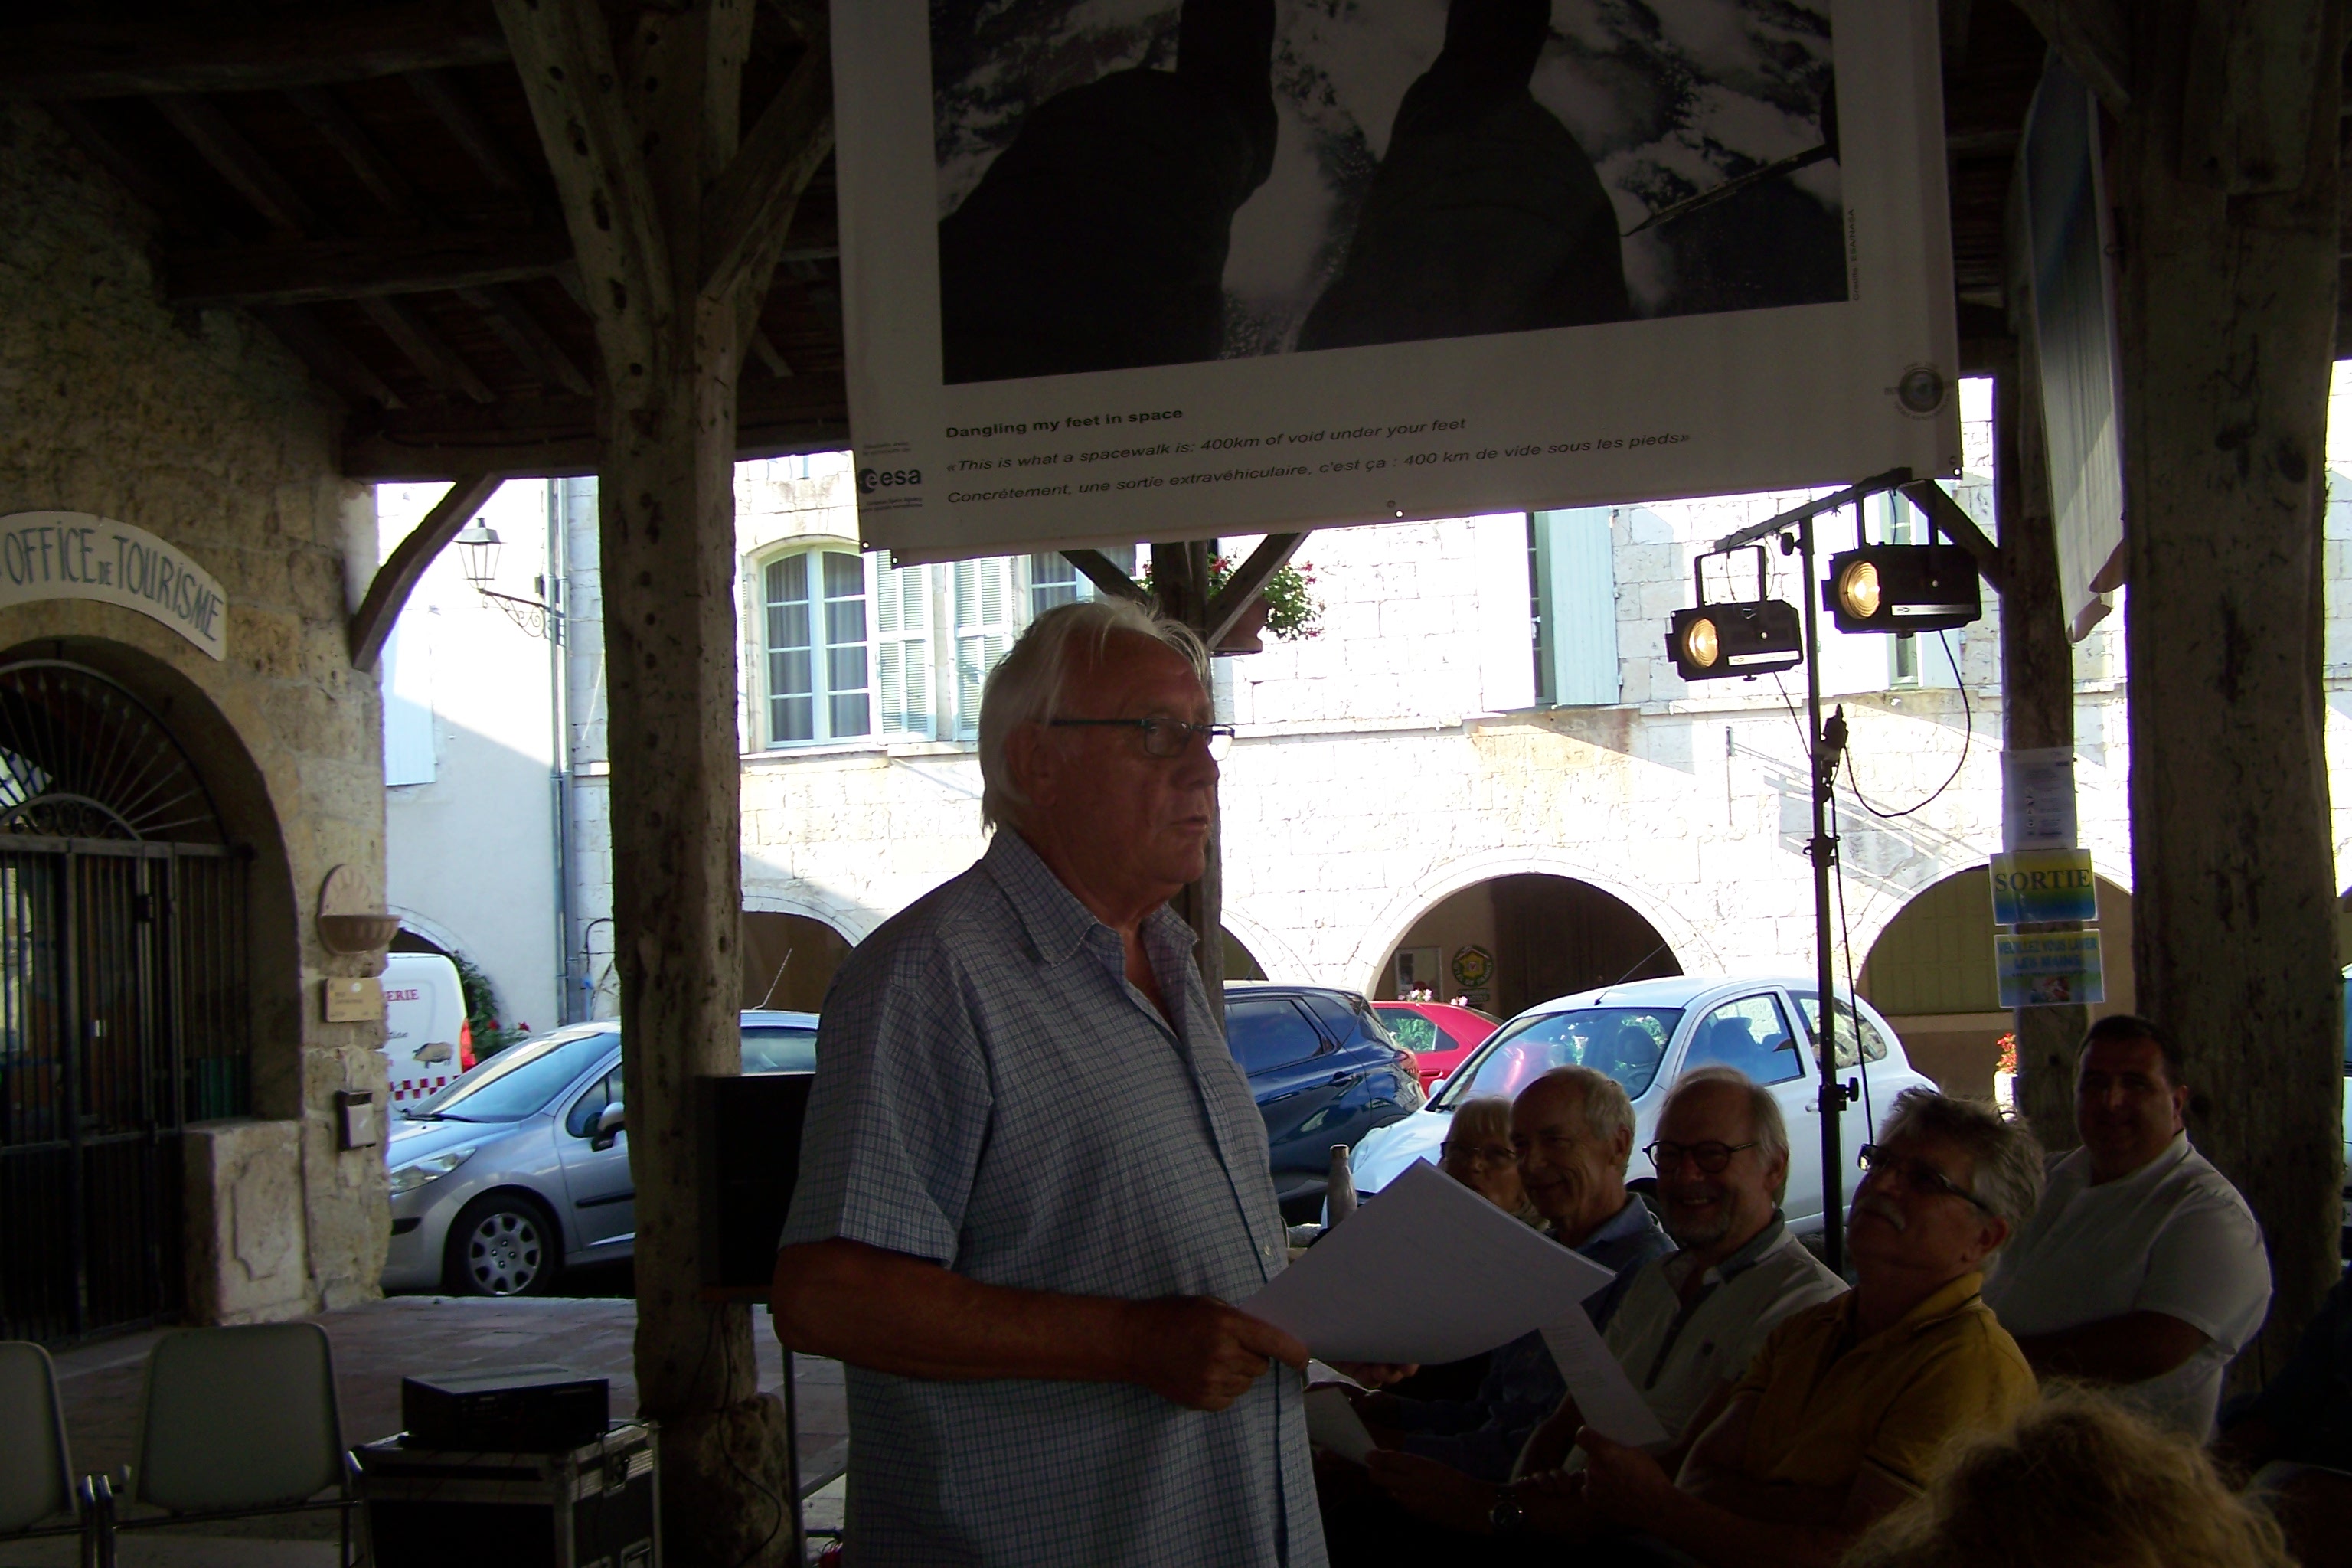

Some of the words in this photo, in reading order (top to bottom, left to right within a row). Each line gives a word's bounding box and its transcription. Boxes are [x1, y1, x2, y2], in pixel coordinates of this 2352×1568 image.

[946, 423, 1027, 438] Dangling
[1034, 420, 1060, 431] my
[1067, 416, 1100, 428] feet
[1106, 413, 1122, 425] in
[1129, 409, 1184, 424] space
[998, 457, 1011, 468] is
[1018, 452, 1058, 466] what
[1063, 453, 1073, 462] a
[1080, 443, 1171, 462] spacewalk
[1175, 443, 1194, 453] is:
[1200, 436, 1260, 452] 400km
[1265, 433, 1284, 446] of
[1289, 430, 1325, 443] void
[1331, 426, 1381, 441] under
[1387, 423, 1427, 438] your
[1432, 419, 1467, 432] feet
[880, 469, 921, 487] esa
[948, 484, 1072, 503] Concrètement,
[1079, 482, 1110, 493] une
[1116, 475, 1163, 491] sortie
[1169, 465, 1312, 486] extravéhiculaire,
[1318, 457, 1359, 473] c'est
[1365, 459, 1387, 472] ça
[1403, 452, 1438, 466] 400
[1442, 449, 1470, 462] km
[1475, 447, 1498, 460] de
[1504, 444, 1541, 458] vide
[1547, 440, 1591, 453] sous
[1596, 437, 1624, 449] les
[1994, 868, 2091, 892] SORTIE
